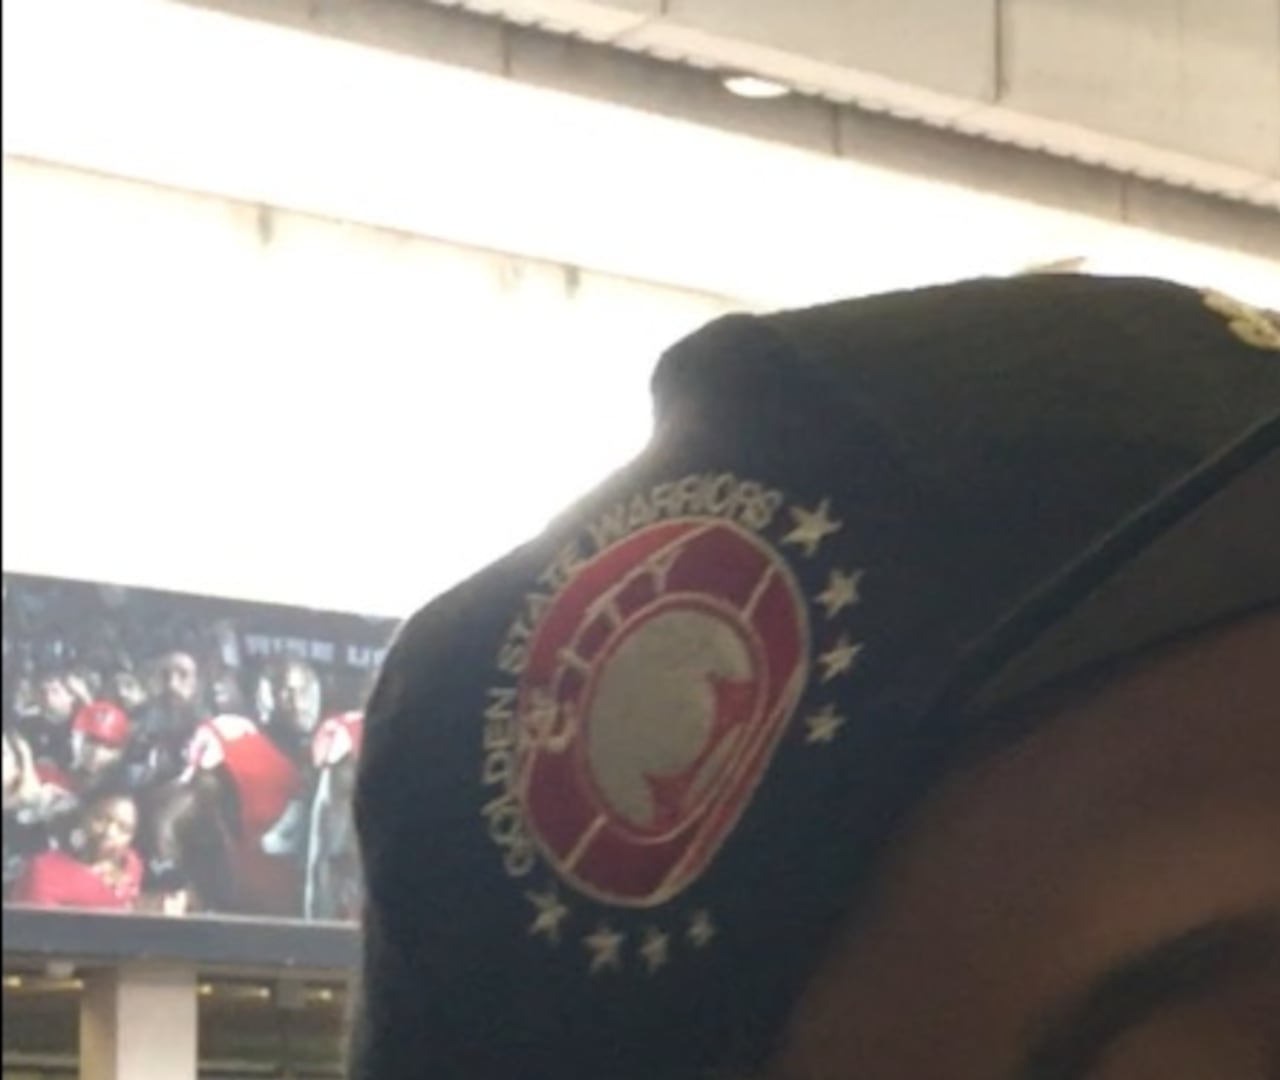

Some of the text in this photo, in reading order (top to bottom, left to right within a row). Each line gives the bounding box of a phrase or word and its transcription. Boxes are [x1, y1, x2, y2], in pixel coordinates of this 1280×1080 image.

[587, 473, 783, 545] WARRIORS
[496, 540, 587, 674] STATE
[481, 686, 535, 876] GOLDEN
